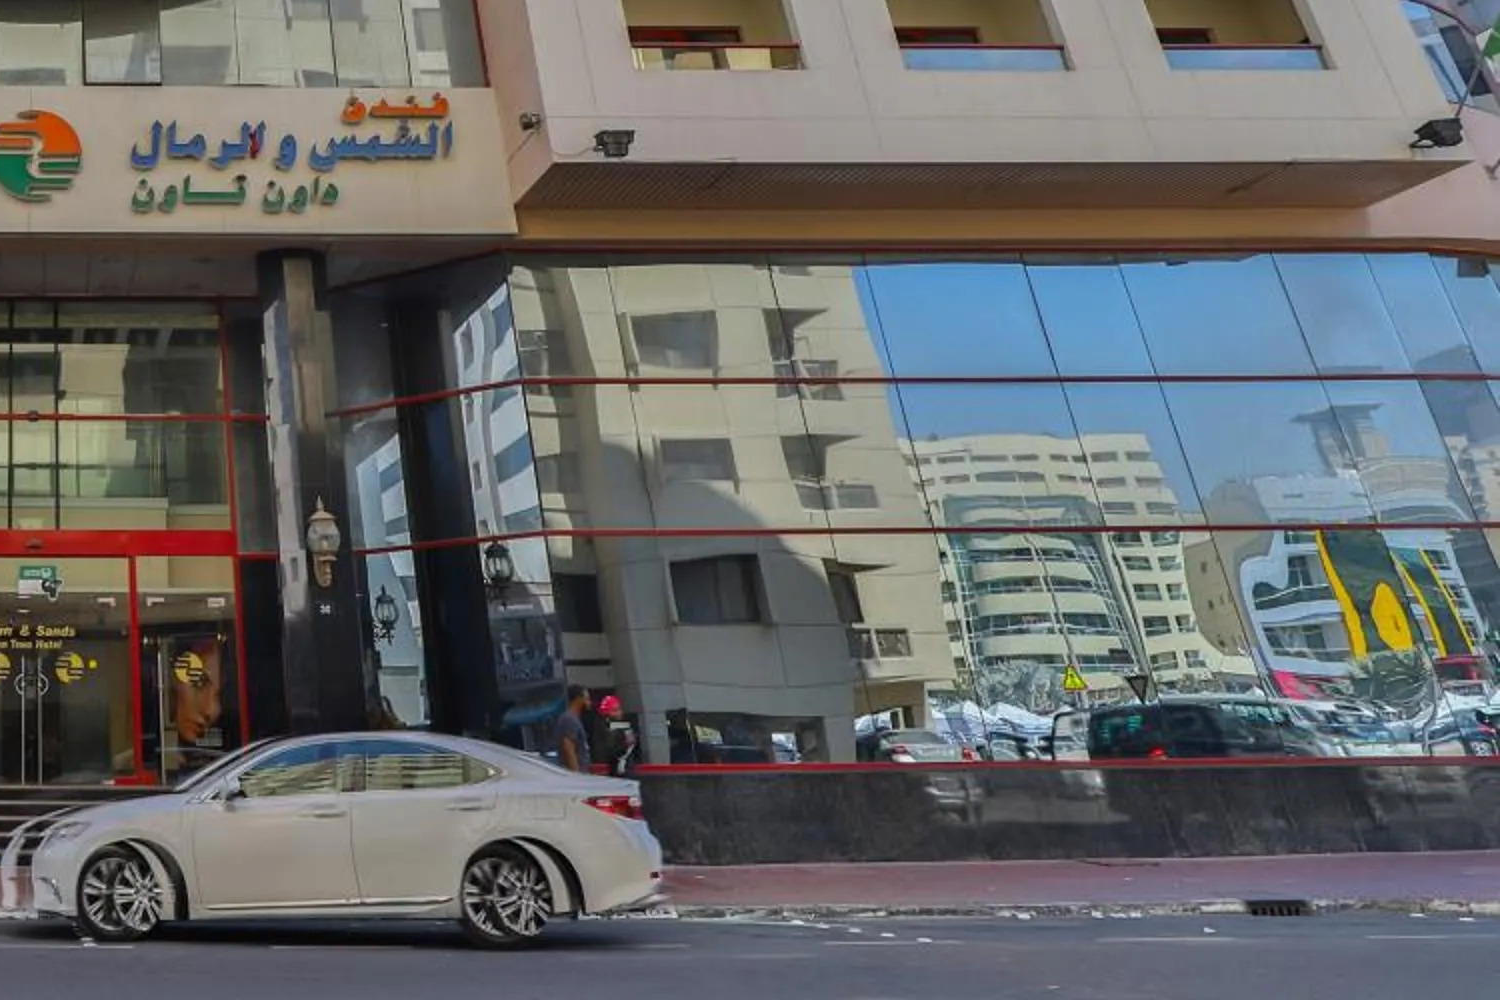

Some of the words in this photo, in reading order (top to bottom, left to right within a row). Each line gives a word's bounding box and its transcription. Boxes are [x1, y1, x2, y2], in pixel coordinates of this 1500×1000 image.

[308, 119, 453, 173] الشمس
[131, 174, 247, 214] تاون
[262, 175, 340, 214] داون
[35, 624, 76, 638] Sands
